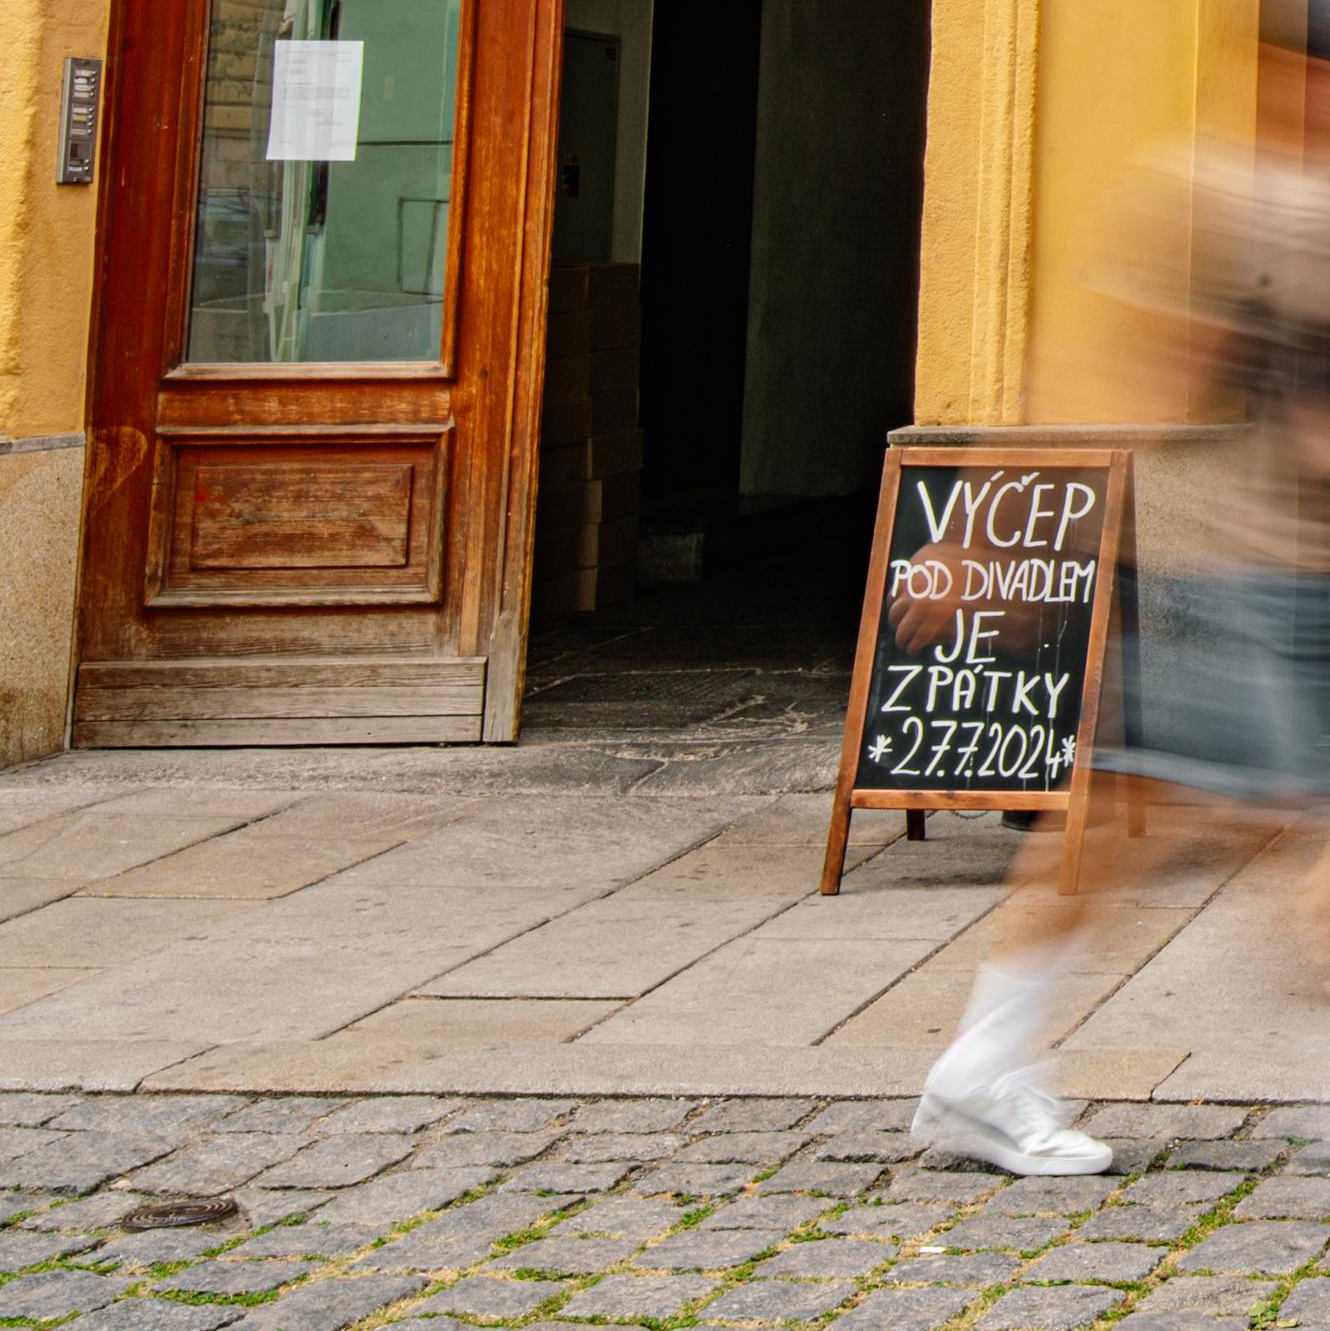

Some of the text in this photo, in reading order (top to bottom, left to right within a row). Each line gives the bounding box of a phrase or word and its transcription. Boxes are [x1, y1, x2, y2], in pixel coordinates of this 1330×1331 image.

[917, 470, 1096, 551] VÝČEP
[890, 558, 1095, 604] POD DIVADLEM
[935, 608, 1006, 665] JE
[881, 664, 1070, 719] ZPÁTKY
